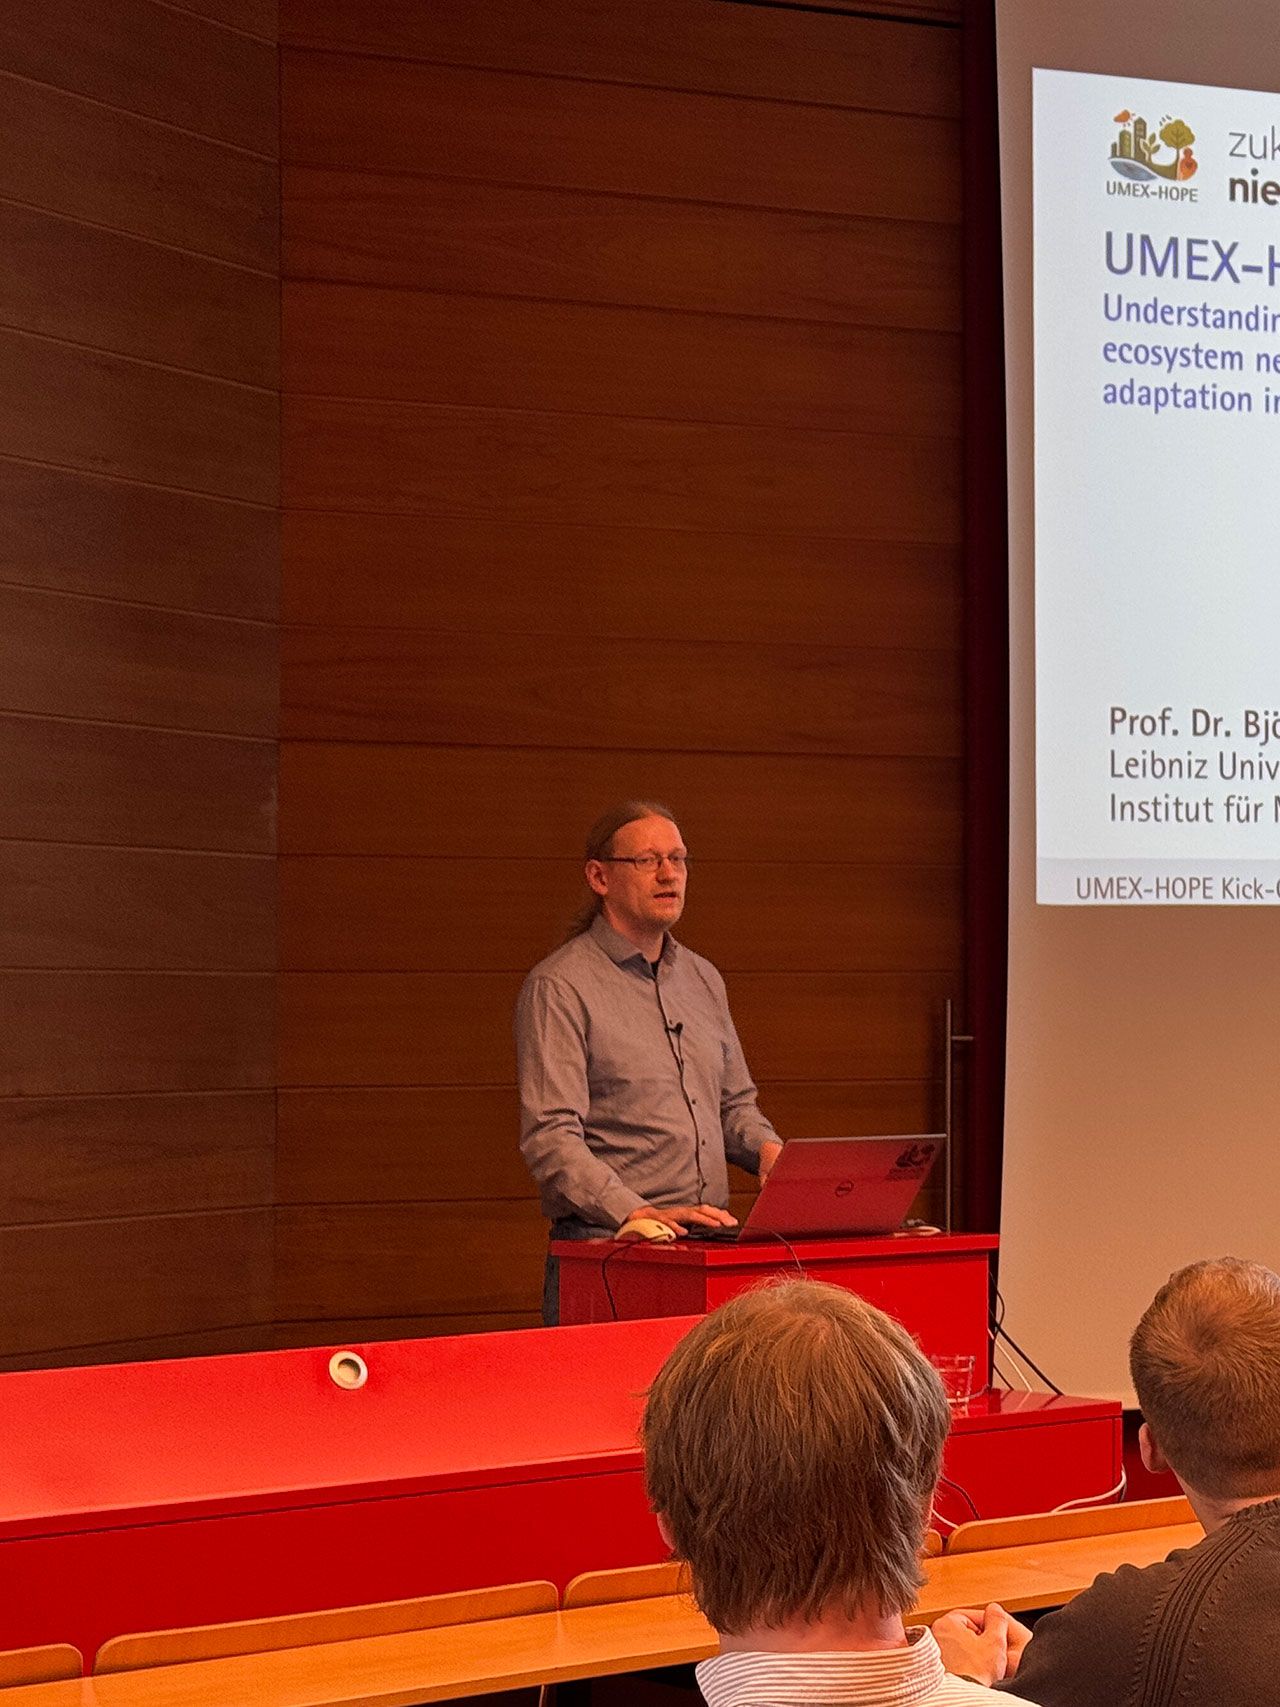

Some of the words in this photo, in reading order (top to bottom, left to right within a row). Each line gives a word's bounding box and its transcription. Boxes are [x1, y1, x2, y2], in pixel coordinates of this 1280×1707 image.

[1106, 180, 1199, 204] UMEX-HOPE
[1102, 341, 1244, 376] ecosystem
[1102, 377, 1253, 416] adaptation
[1109, 706, 1180, 738] Prof.
[1191, 707, 1232, 738] Dr.
[1110, 748, 1209, 780] Leibniz
[1110, 792, 1216, 824] Institut
[1223, 793, 1265, 825] für
[1076, 875, 1214, 900] UMEX-HOPE
